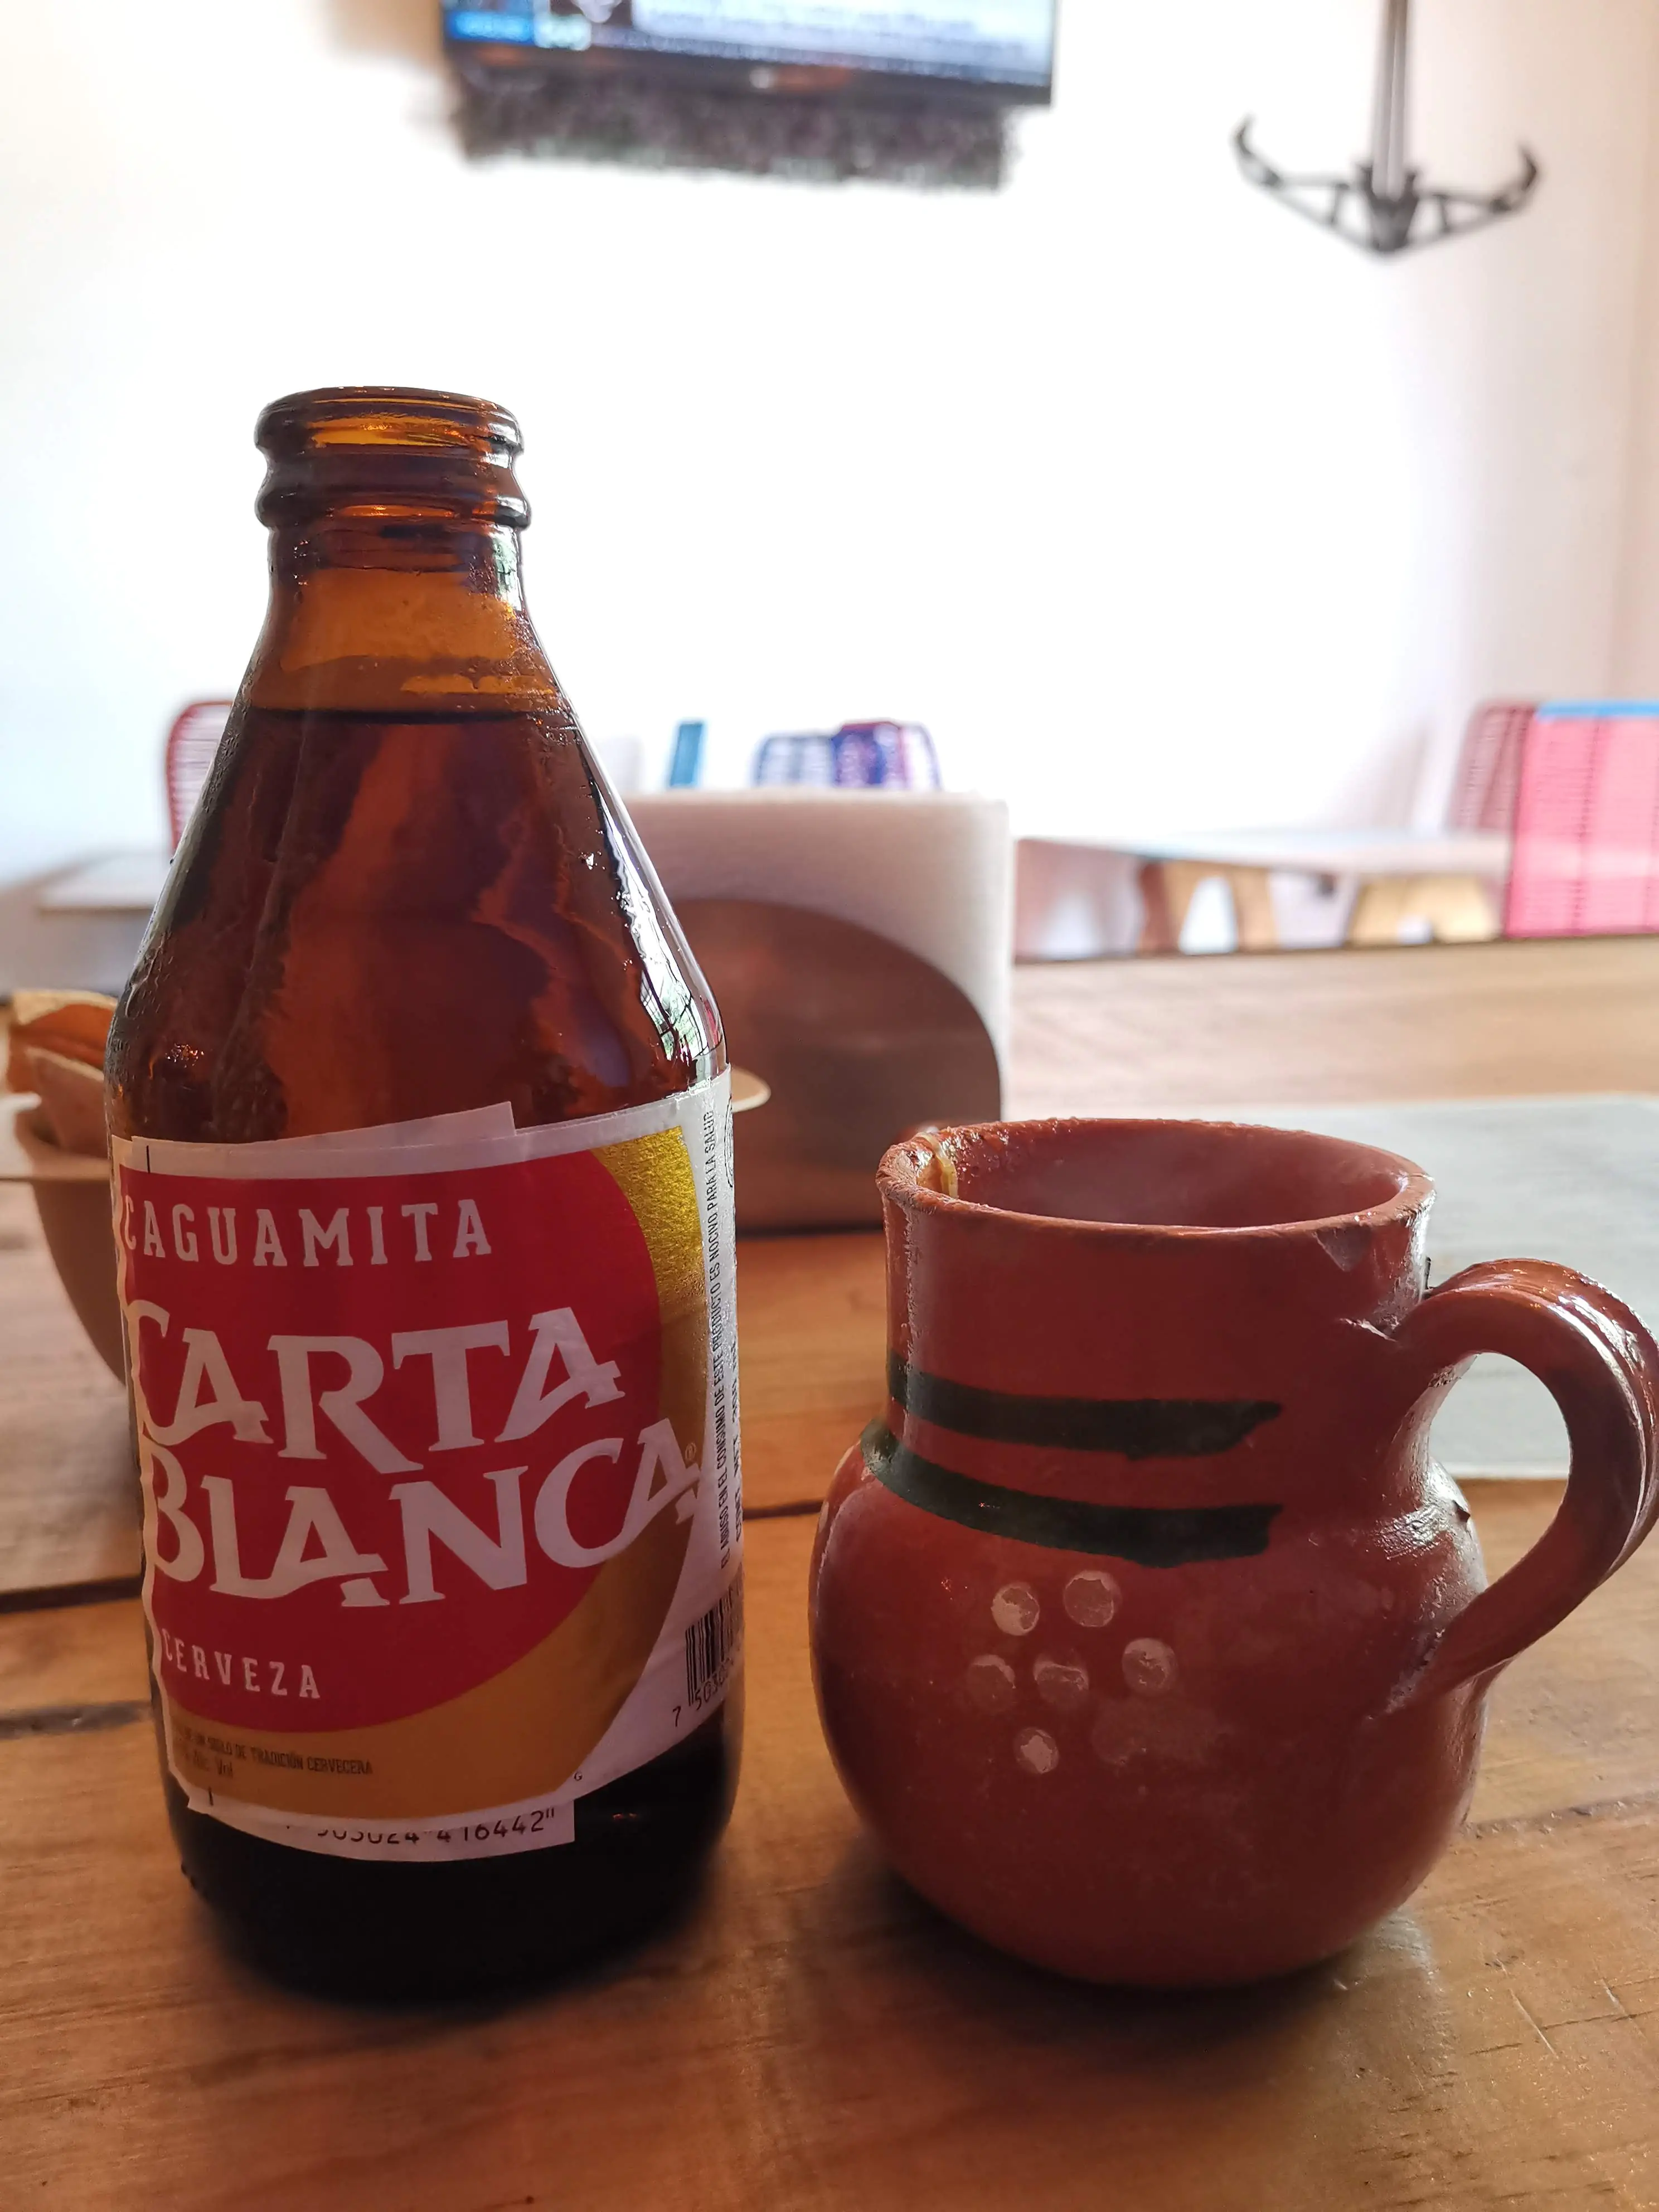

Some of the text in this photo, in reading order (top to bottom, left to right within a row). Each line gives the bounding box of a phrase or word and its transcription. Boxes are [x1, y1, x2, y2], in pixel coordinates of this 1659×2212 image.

[705, 1154, 716, 1174] LA
[706, 1174, 717, 1211] PARA
[124, 1195, 492, 1267] CAGUAMITA
[708, 1213, 720, 1262] NOCIVO
[710, 1263, 720, 1282] ES
[710, 1283, 723, 1351] PRODUCTO
[714, 1350, 724, 1386] ESTE
[127, 1301, 625, 1474] CARTA
[714, 1385, 724, 1406] DE
[715, 1405, 727, 1469] CONSUMO
[718, 1467, 727, 1488] EL
[719, 1485, 729, 1507] EN
[141, 1418, 701, 1607] BLANCA
[719, 1506, 730, 1550] ABUSO
[721, 1549, 731, 1569] EL
[162, 1628, 321, 1699] CERVEZA
[307, 1756, 373, 1774] CERVECERA
